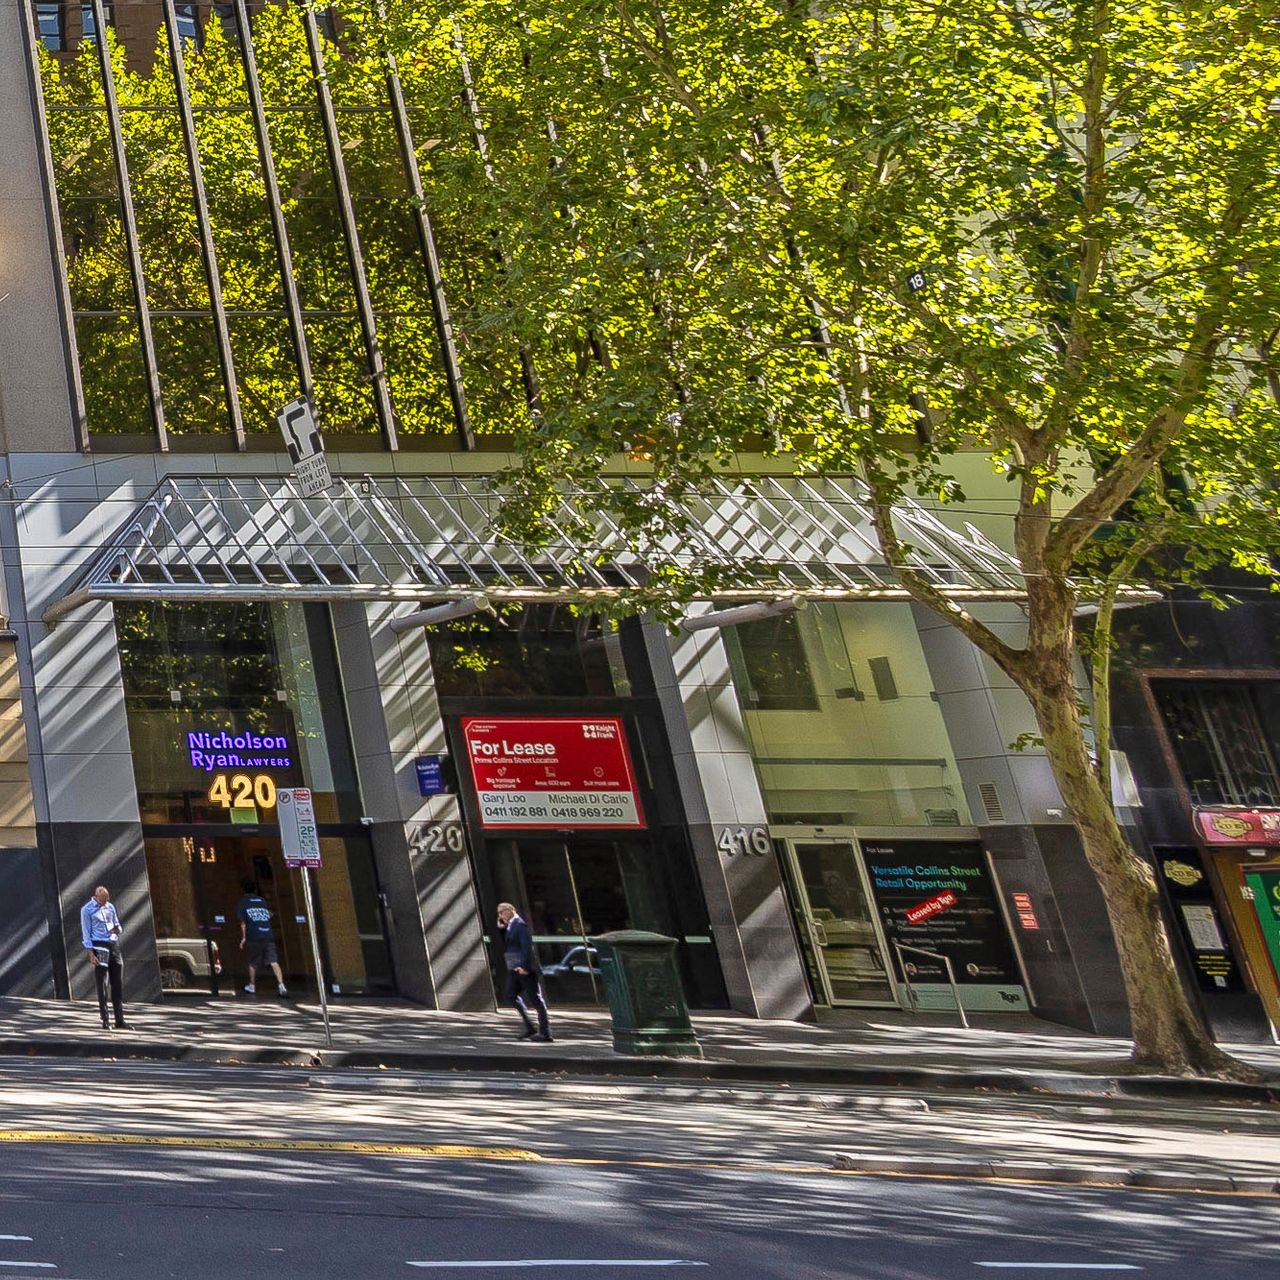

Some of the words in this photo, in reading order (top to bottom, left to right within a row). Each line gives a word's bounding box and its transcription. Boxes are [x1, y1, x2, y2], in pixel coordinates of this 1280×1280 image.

[188, 731, 288, 749] Nicholson
[470, 740, 500, 755] For
[503, 740, 556, 755] Lease
[190, 750, 240, 771] Ryan
[240, 758, 290, 767] LAWYERS
[474, 756, 492, 764] Prime
[209, 773, 277, 809] 420
[482, 793, 507, 807] Gary
[507, 793, 526, 803] Loo
[548, 794, 589, 804] Michael
[589, 794, 600, 804] Di
[601, 794, 629, 805] Carlo
[484, 806, 508, 817] 0411
[510, 806, 528, 816] 192
[529, 807, 548, 817] 881
[552, 807, 578, 818] 0418
[579, 808, 601, 818] 969
[602, 808, 624, 818] 220
[300, 825, 315, 835] 2P
[409, 825, 463, 853] 420
[717, 827, 771, 856] 416
[871, 866, 914, 876] Versatile
[915, 865, 950, 876] Collins
[950, 866, 981, 877] Street
[875, 878, 904, 888] Retail
[905, 878, 967, 891] Opportunity
[907, 903, 932, 921] Leased
[931, 900, 942, 911] by
